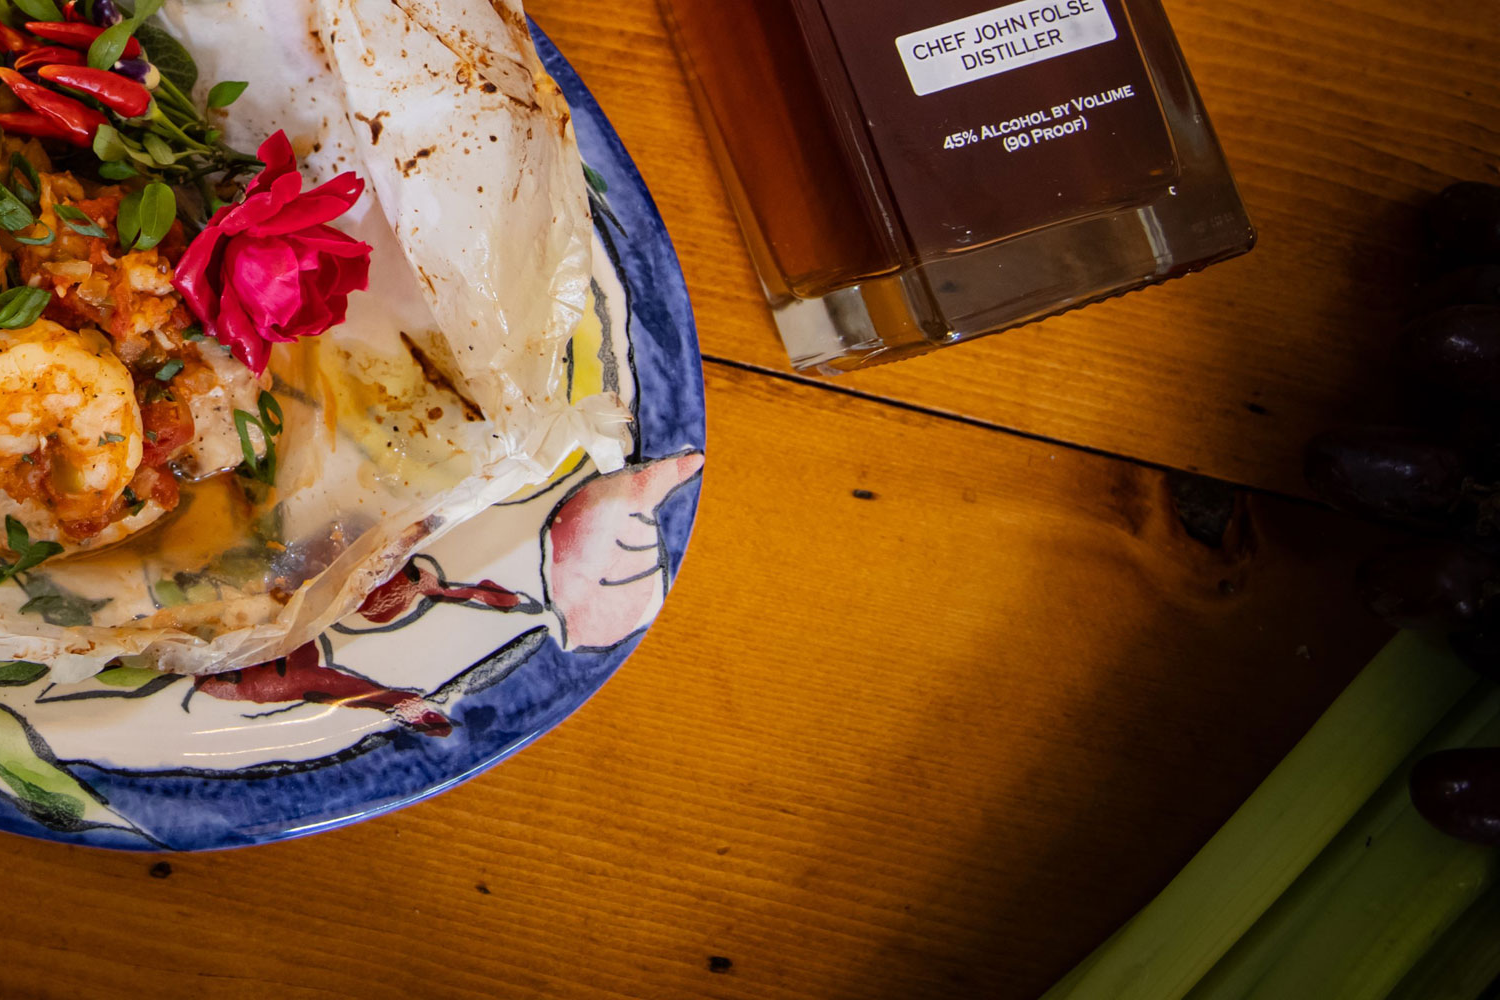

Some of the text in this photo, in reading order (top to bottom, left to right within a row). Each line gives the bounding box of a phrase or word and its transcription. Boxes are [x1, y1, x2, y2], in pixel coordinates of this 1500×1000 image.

[911, 32, 968, 62] CHEF
[973, 14, 1028, 45] JOHN
[961, 28, 1064, 71] DISTILLER
[943, 84, 1135, 152] 45% ALCOHOL BY VOLUME
[1002, 131, 1031, 153] (90
